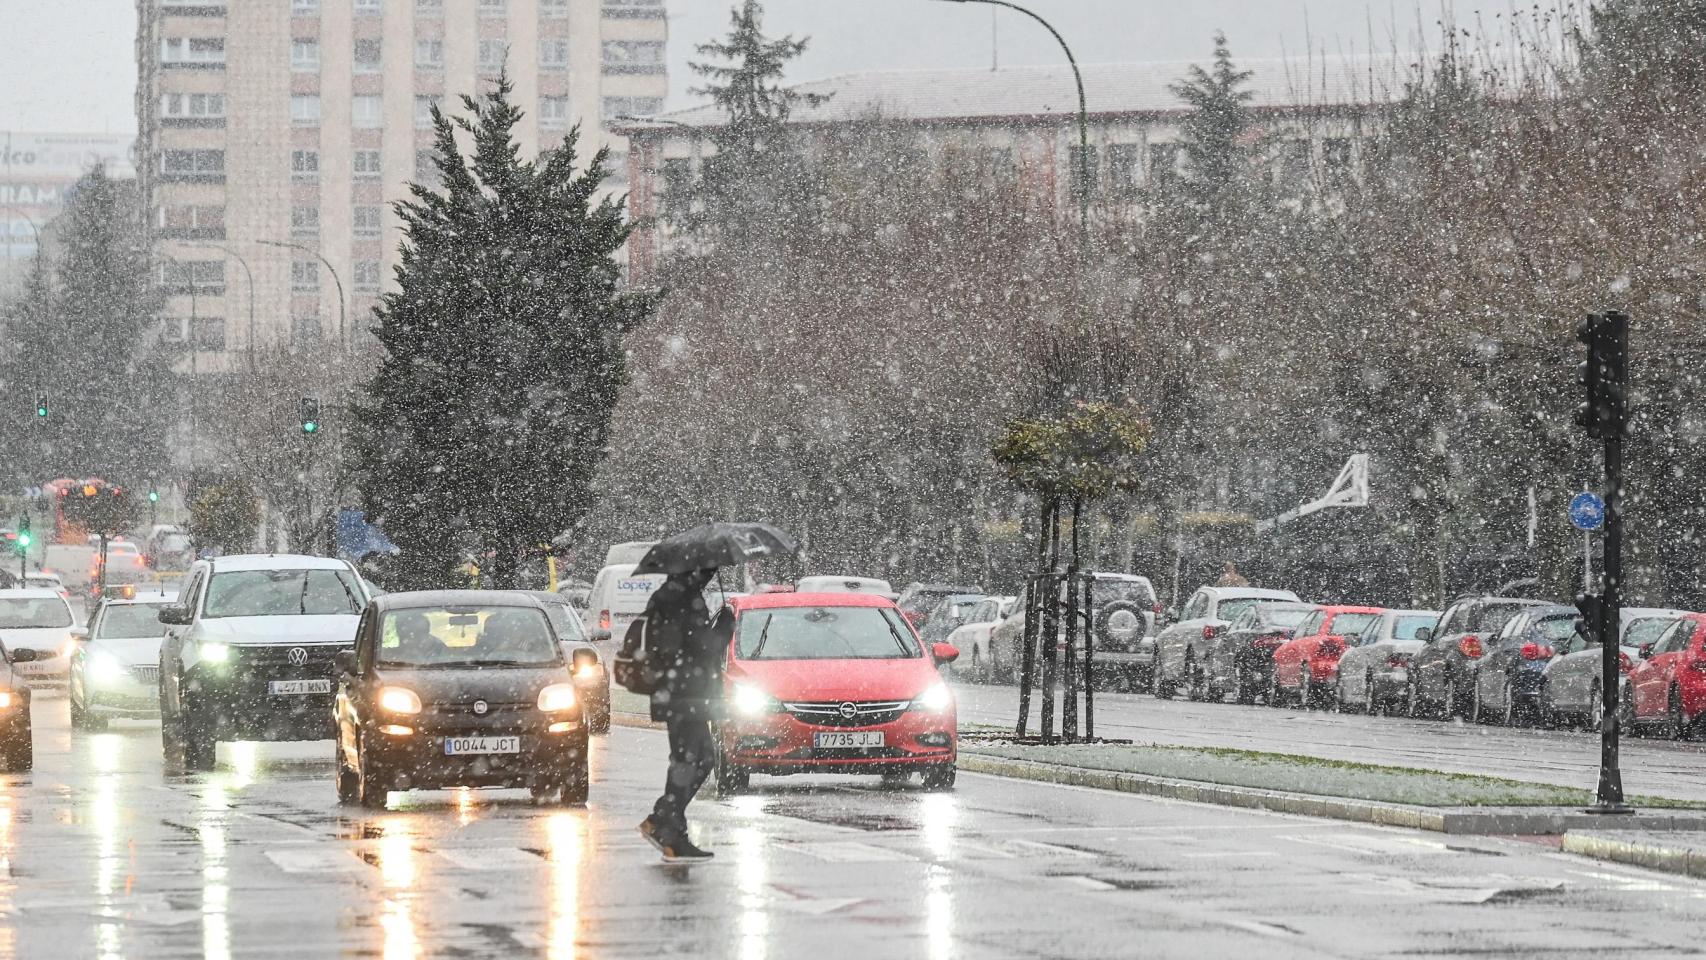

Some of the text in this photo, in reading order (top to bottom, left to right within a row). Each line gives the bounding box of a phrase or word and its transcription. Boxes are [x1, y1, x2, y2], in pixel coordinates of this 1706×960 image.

[454, 738, 516, 752] 0044 JCT
[822, 733, 881, 746] 7735 JLJ
